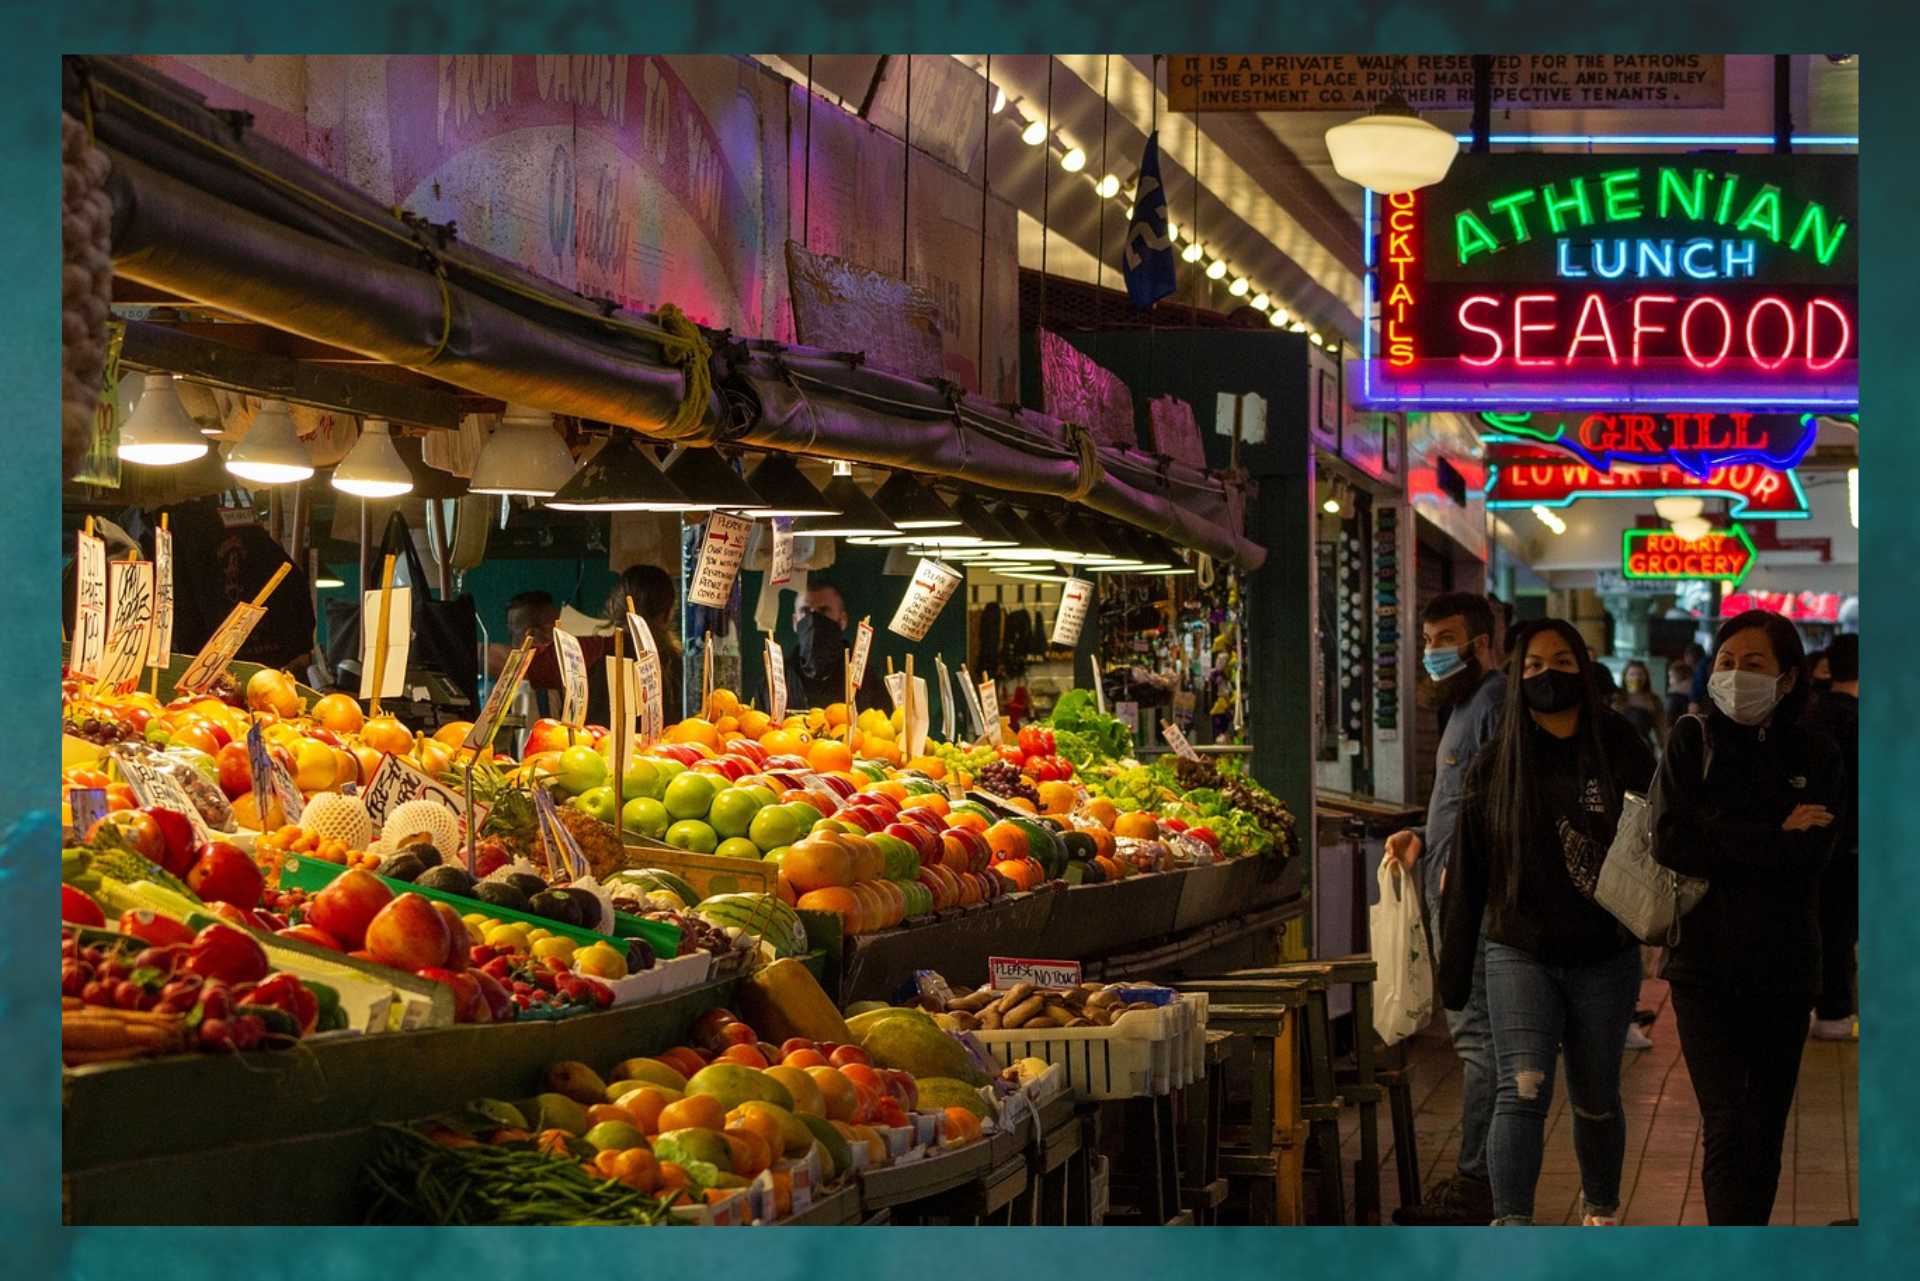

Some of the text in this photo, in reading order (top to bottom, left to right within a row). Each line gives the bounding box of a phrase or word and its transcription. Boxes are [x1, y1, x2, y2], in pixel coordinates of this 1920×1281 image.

[1181, 73, 1203, 88] OF
[1211, 73, 1241, 87] THE
[1251, 73, 1290, 86] PIKE
[1300, 73, 1357, 86] PLACE
[1434, 72, 1519, 86] MARETS
[1575, 71, 1608, 85] AND
[1616, 71, 1642, 84] THE
[1648, 70, 1706, 84] FAIRLEY
[1185, 57, 1200, 71] IT
[1210, 57, 1228, 71] IS
[1238, 56, 1252, 71] A
[1261, 56, 1343, 71] PRIVATE
[1357, 55, 1409, 70] WALK
[1531, 55, 1567, 69] FOR
[1576, 54, 1604, 69] THE
[1613, 54, 1699, 69] PATRONS
[1202, 89, 1309, 103] INVESTMENT
[1455, 166, 1848, 266] ATHENIAN
[1556, 237, 1755, 278] LUNCH
[1388, 190, 1415, 366] OCKTAILS
[1457, 294, 1850, 370] SEAFOOD
[1579, 411, 1769, 452] GRILL
[1628, 553, 1747, 577] GROCERY
[995, 961, 1035, 977] PLEASE
[1034, 969, 1052, 986] NO
